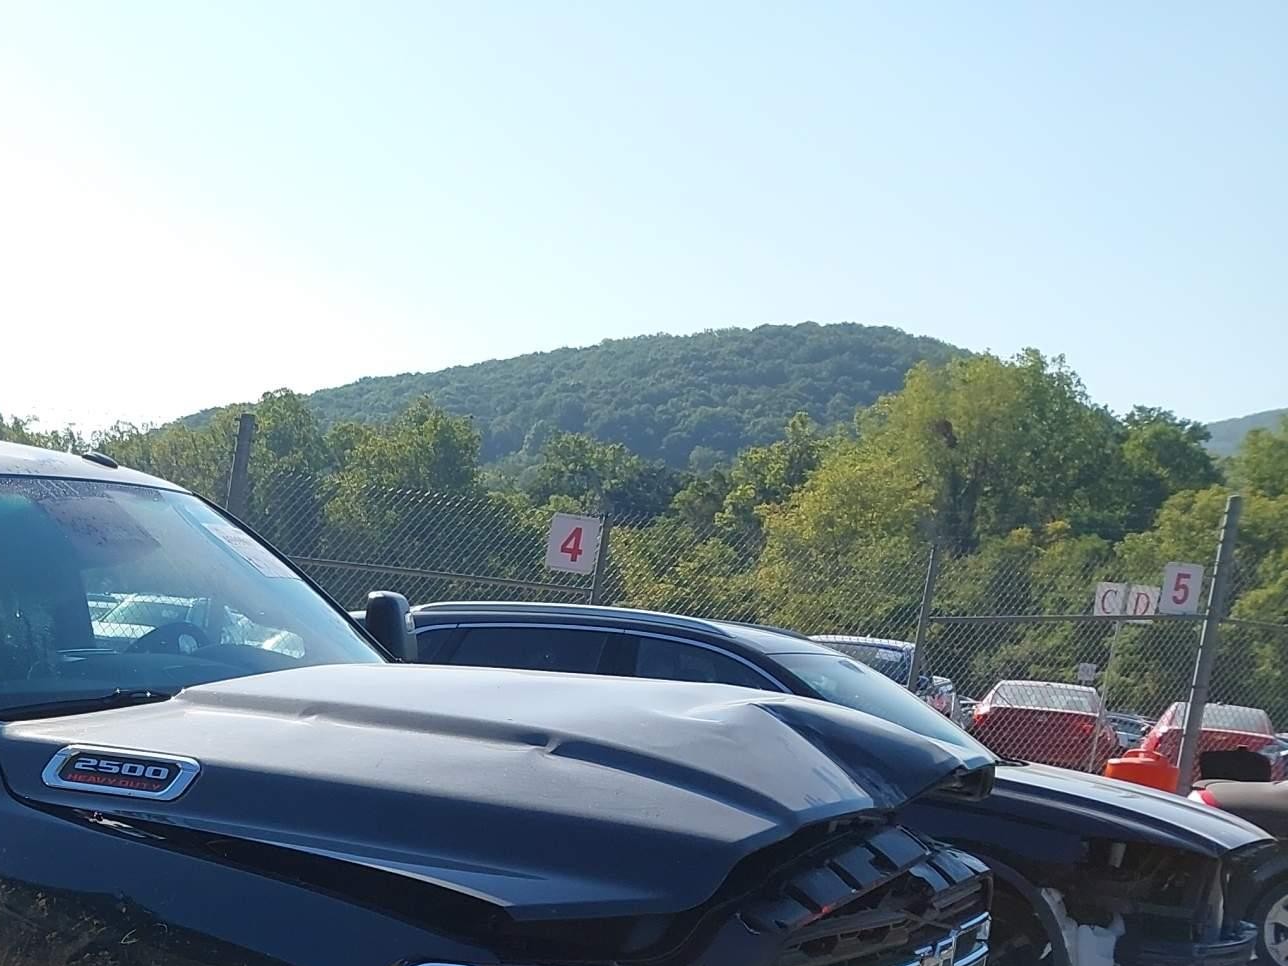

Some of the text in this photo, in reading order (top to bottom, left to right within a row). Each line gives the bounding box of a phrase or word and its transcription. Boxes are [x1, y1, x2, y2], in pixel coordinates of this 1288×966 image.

[560, 527, 582, 562] 4
[1172, 573, 1192, 604] 5
[1101, 589, 1118, 614] C
[1134, 592, 1150, 615] D
[75, 758, 169, 779] 2500
[66, 774, 162, 790] HEAVY DUTY
